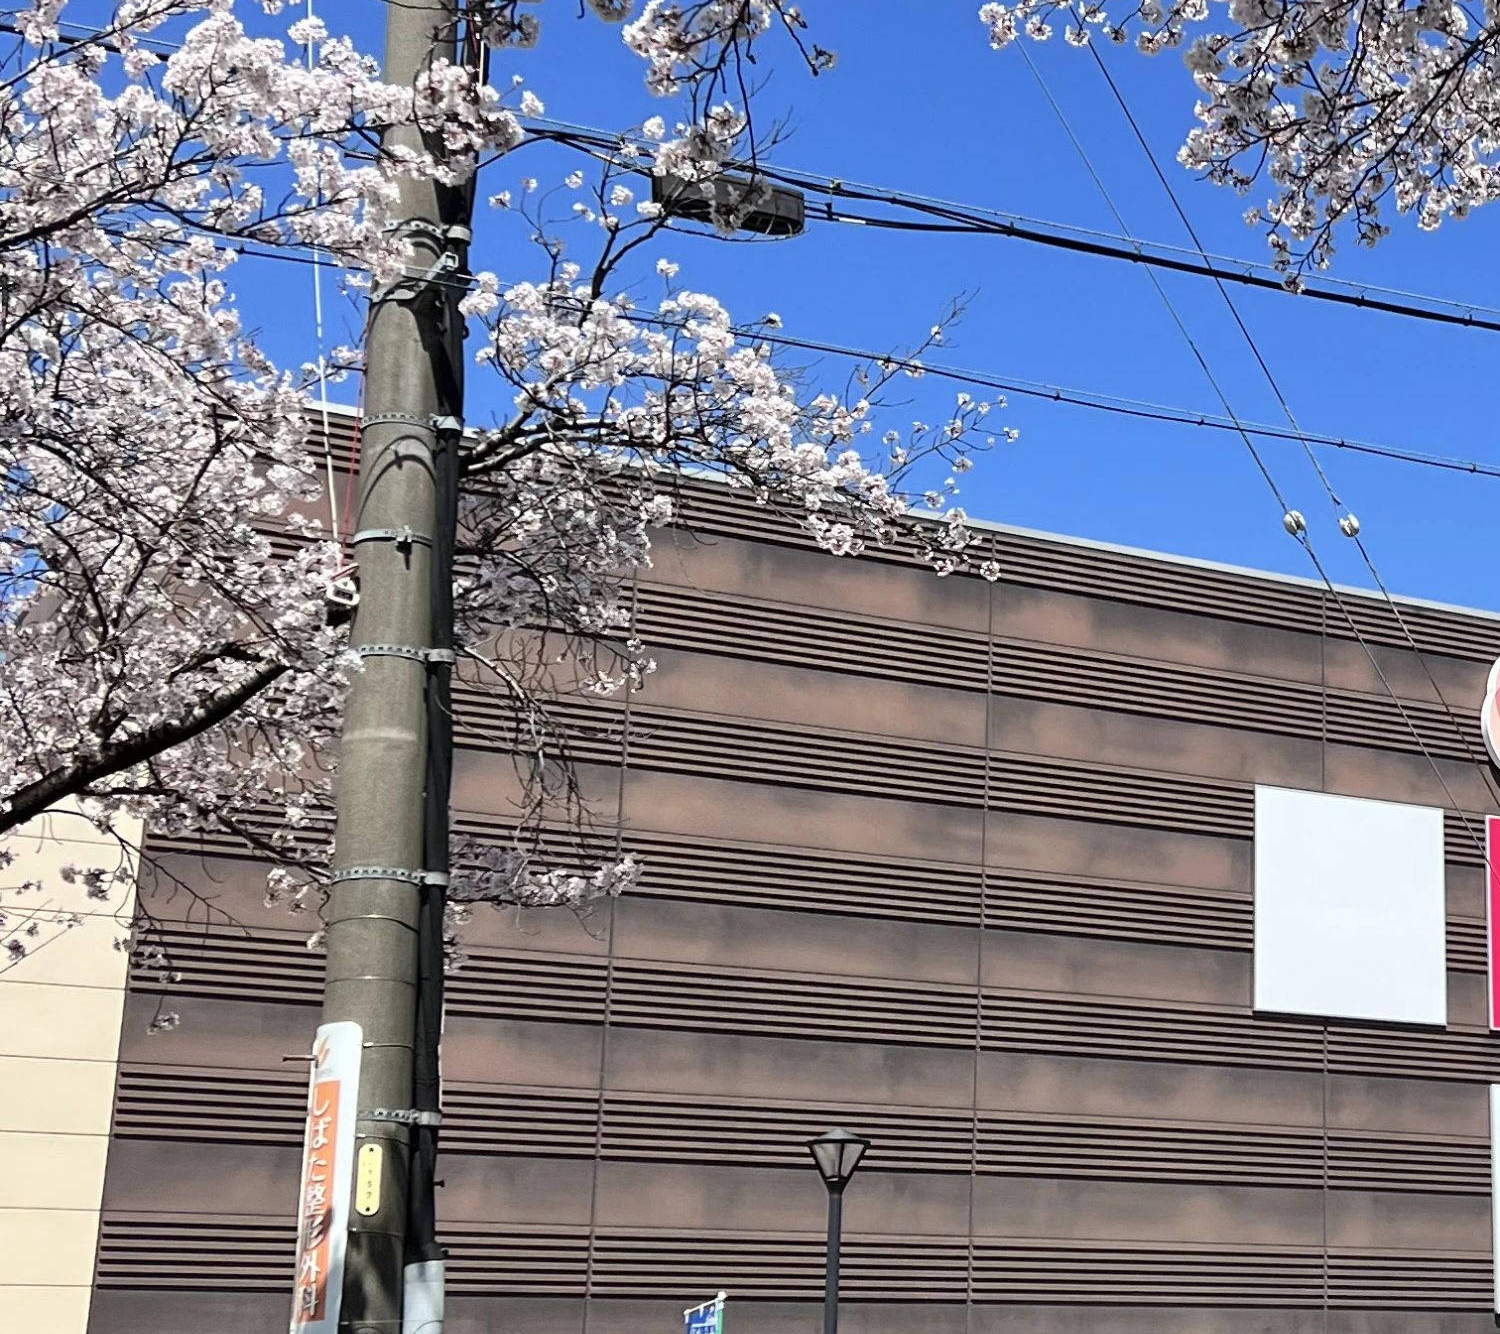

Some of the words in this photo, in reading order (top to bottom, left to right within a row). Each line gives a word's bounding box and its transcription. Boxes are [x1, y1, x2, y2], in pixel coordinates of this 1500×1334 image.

[299, 1086, 332, 1317] しばた整形外科
